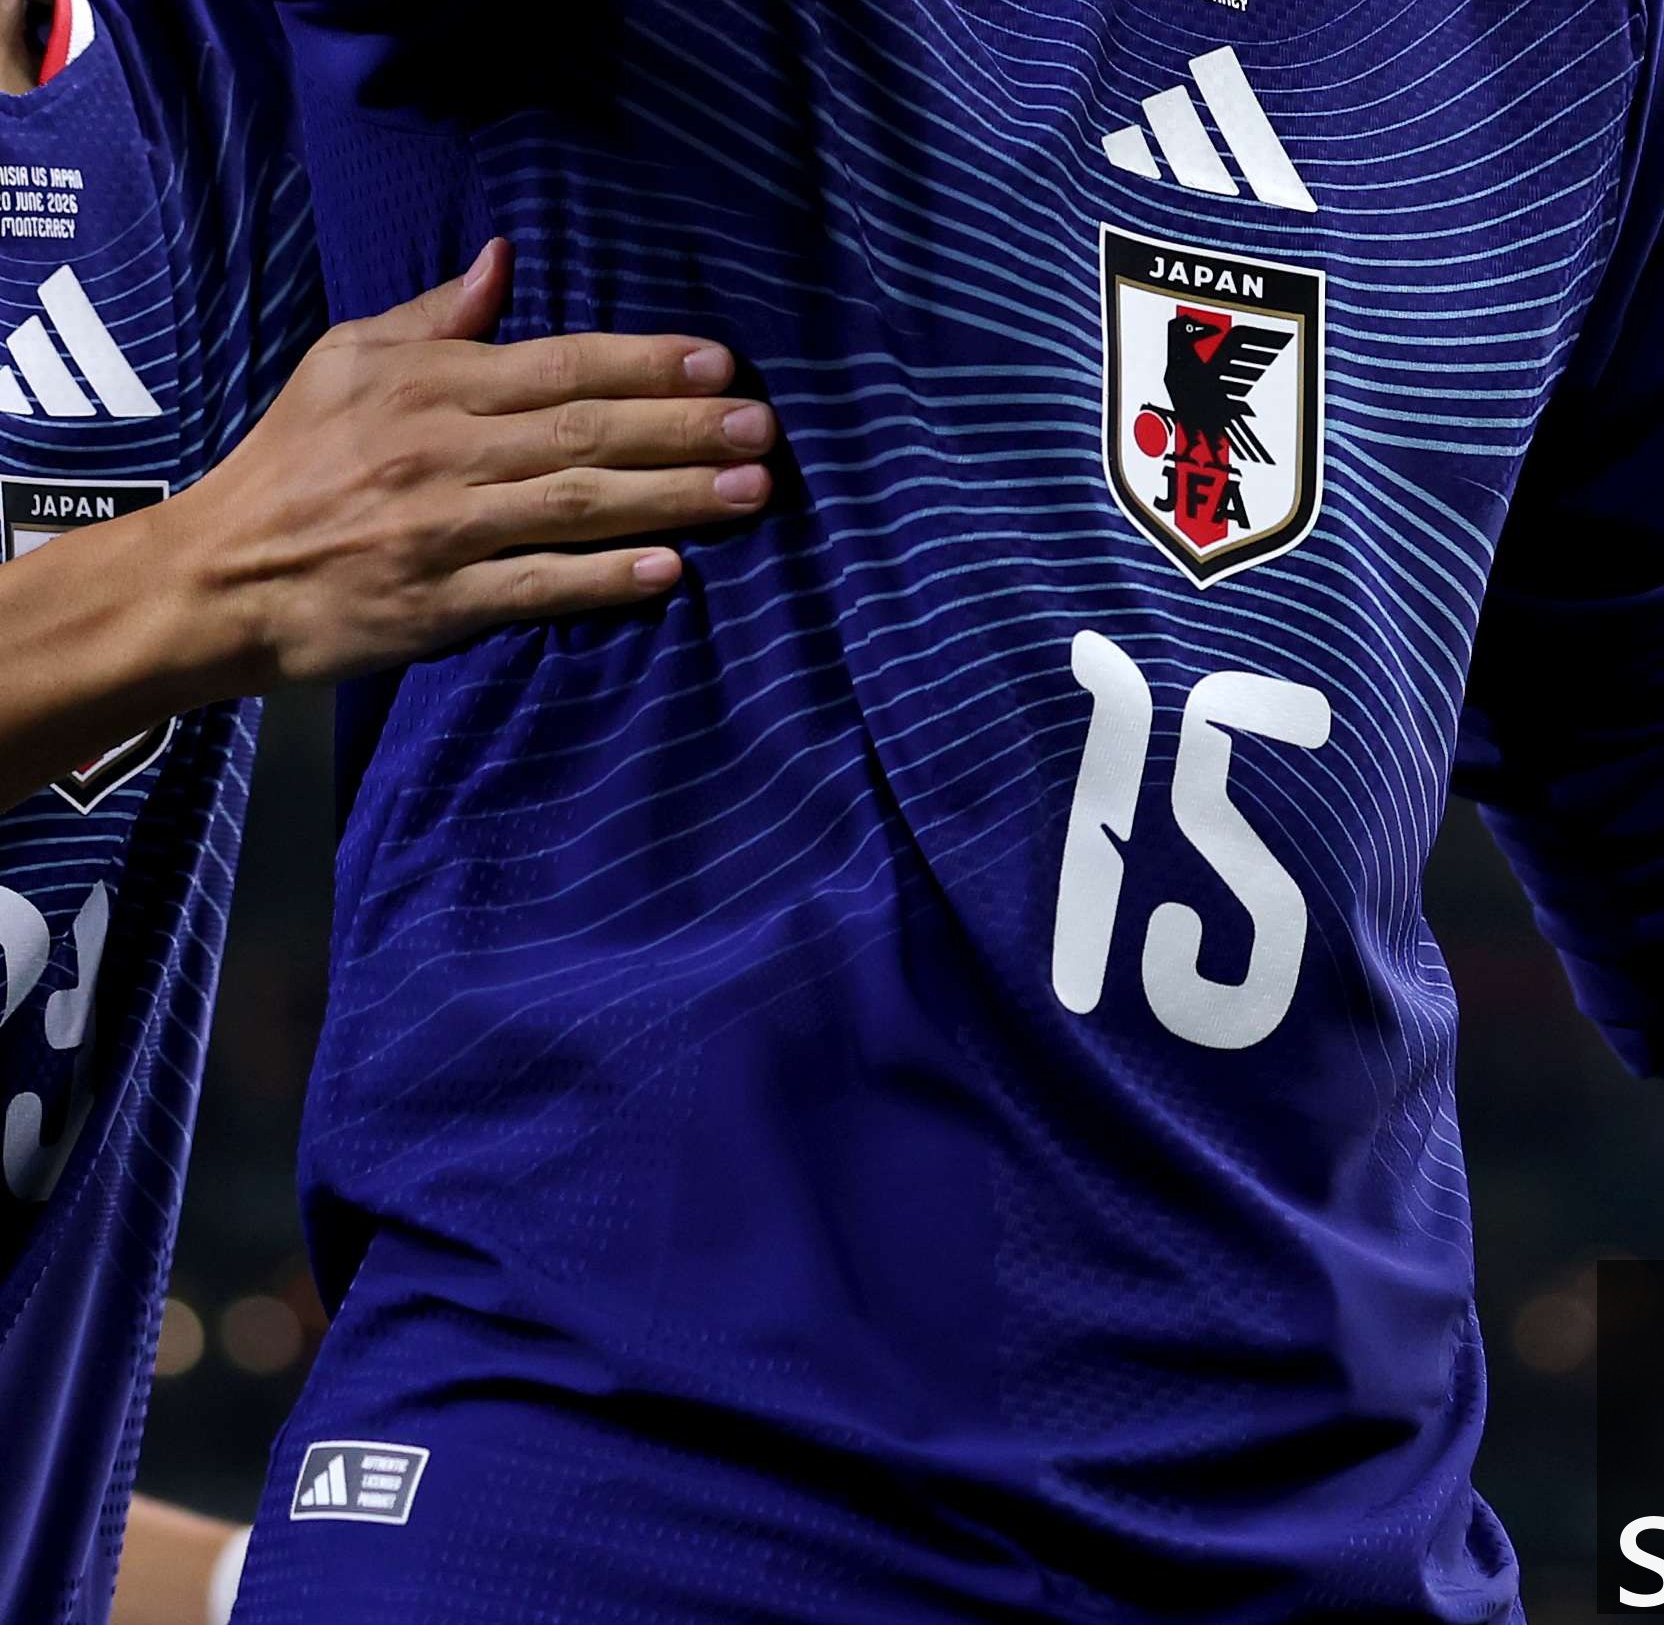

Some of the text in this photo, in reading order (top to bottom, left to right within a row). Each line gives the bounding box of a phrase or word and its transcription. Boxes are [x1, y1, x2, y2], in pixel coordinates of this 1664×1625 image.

[49, 168, 84, 190] JAPAN
[15, 191, 45, 212] JUNE
[46, 192, 79, 214] 2026
[0, 216, 76, 239] MONTERREY
[1149, 256, 1265, 299] JAPAN
[31, 493, 115, 520] JAPAN
[1153, 464, 1251, 530] JFA
[1052, 630, 1332, 1049] 15
